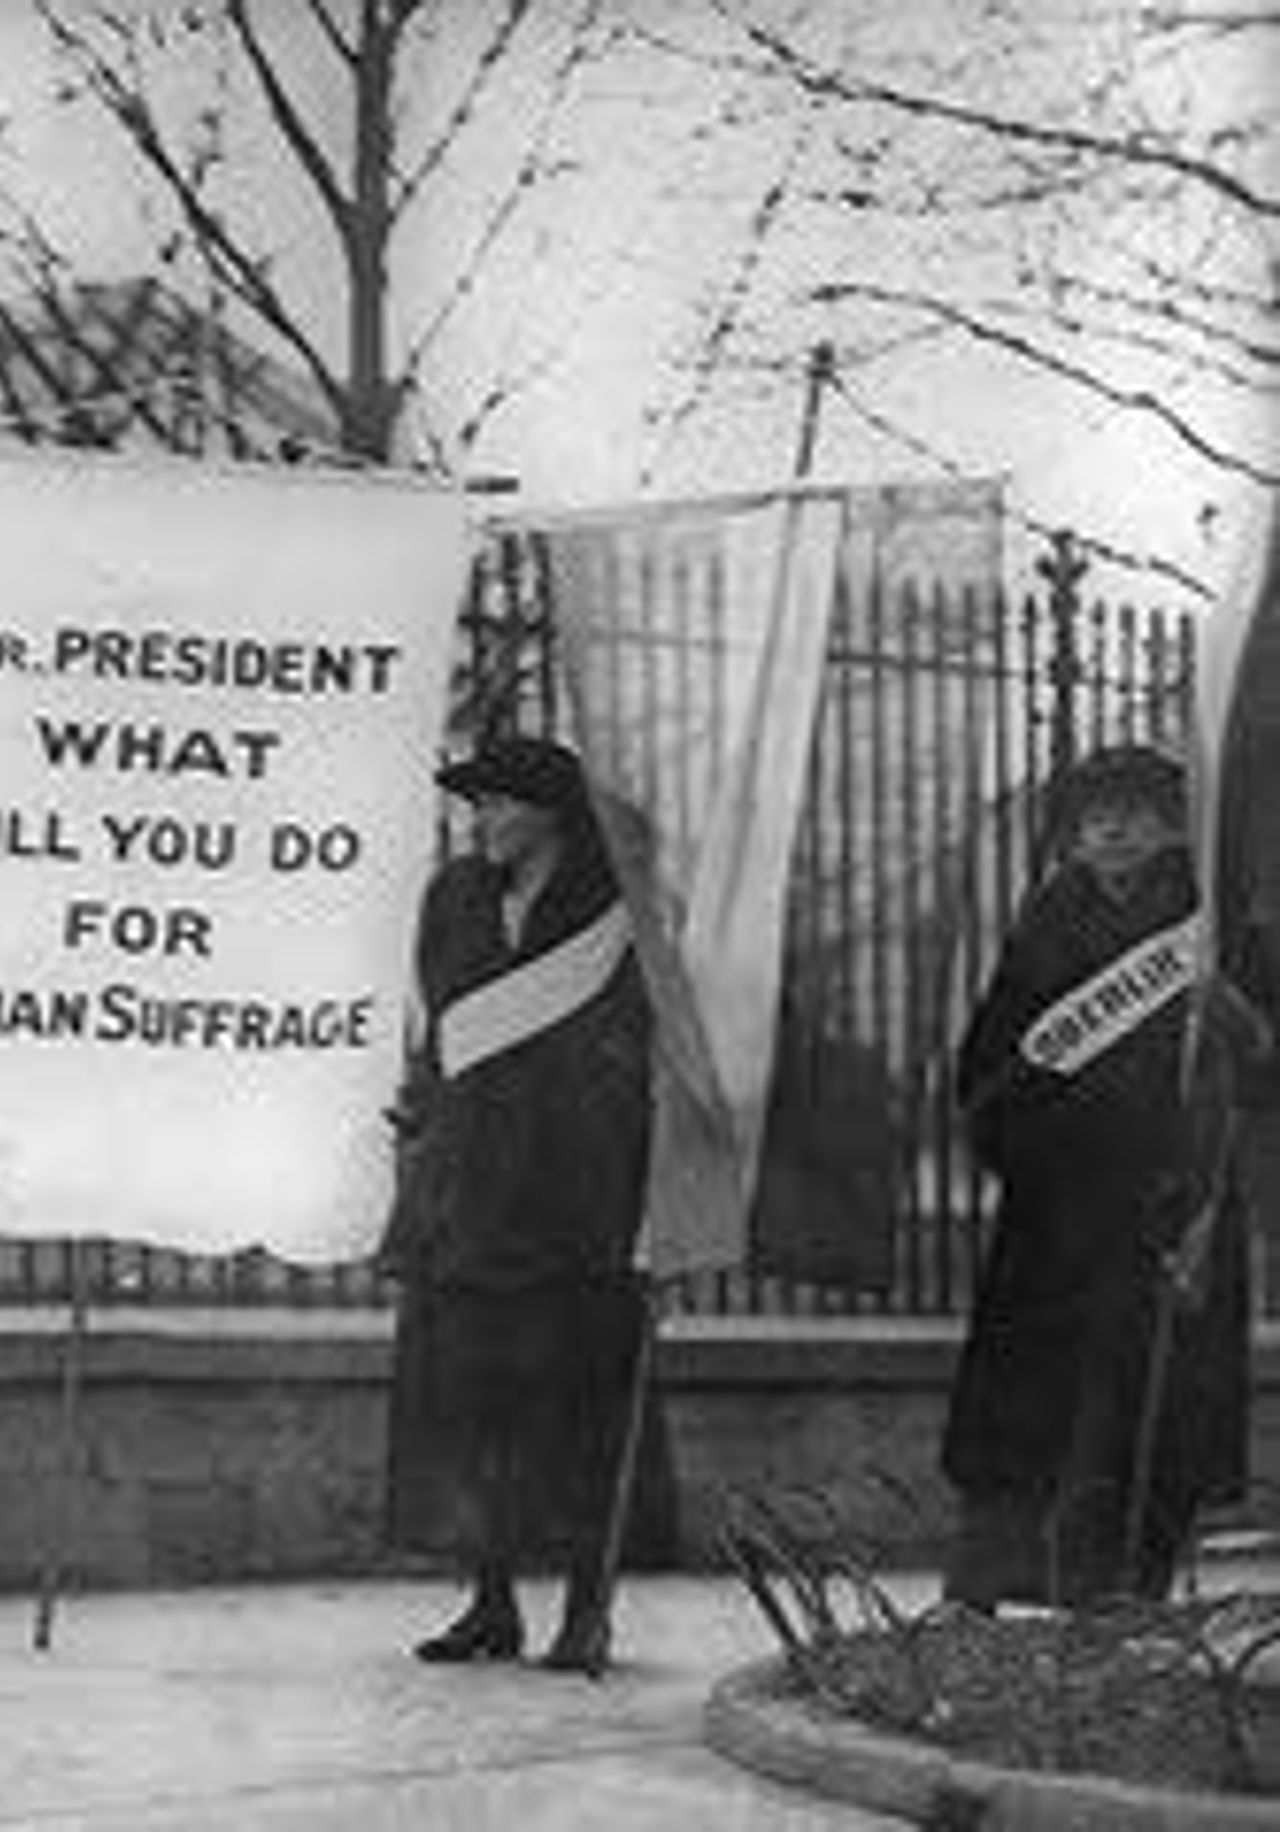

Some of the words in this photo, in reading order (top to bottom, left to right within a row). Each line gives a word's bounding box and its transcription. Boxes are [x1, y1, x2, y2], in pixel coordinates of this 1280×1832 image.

[55, 629, 401, 693] PRESIDENT
[36, 718, 280, 779] WHAT
[102, 815, 235, 870] YOU
[271, 824, 360, 872] DO
[65, 902, 211, 956] FOR
[96, 984, 373, 1049] SUFFRAGE
